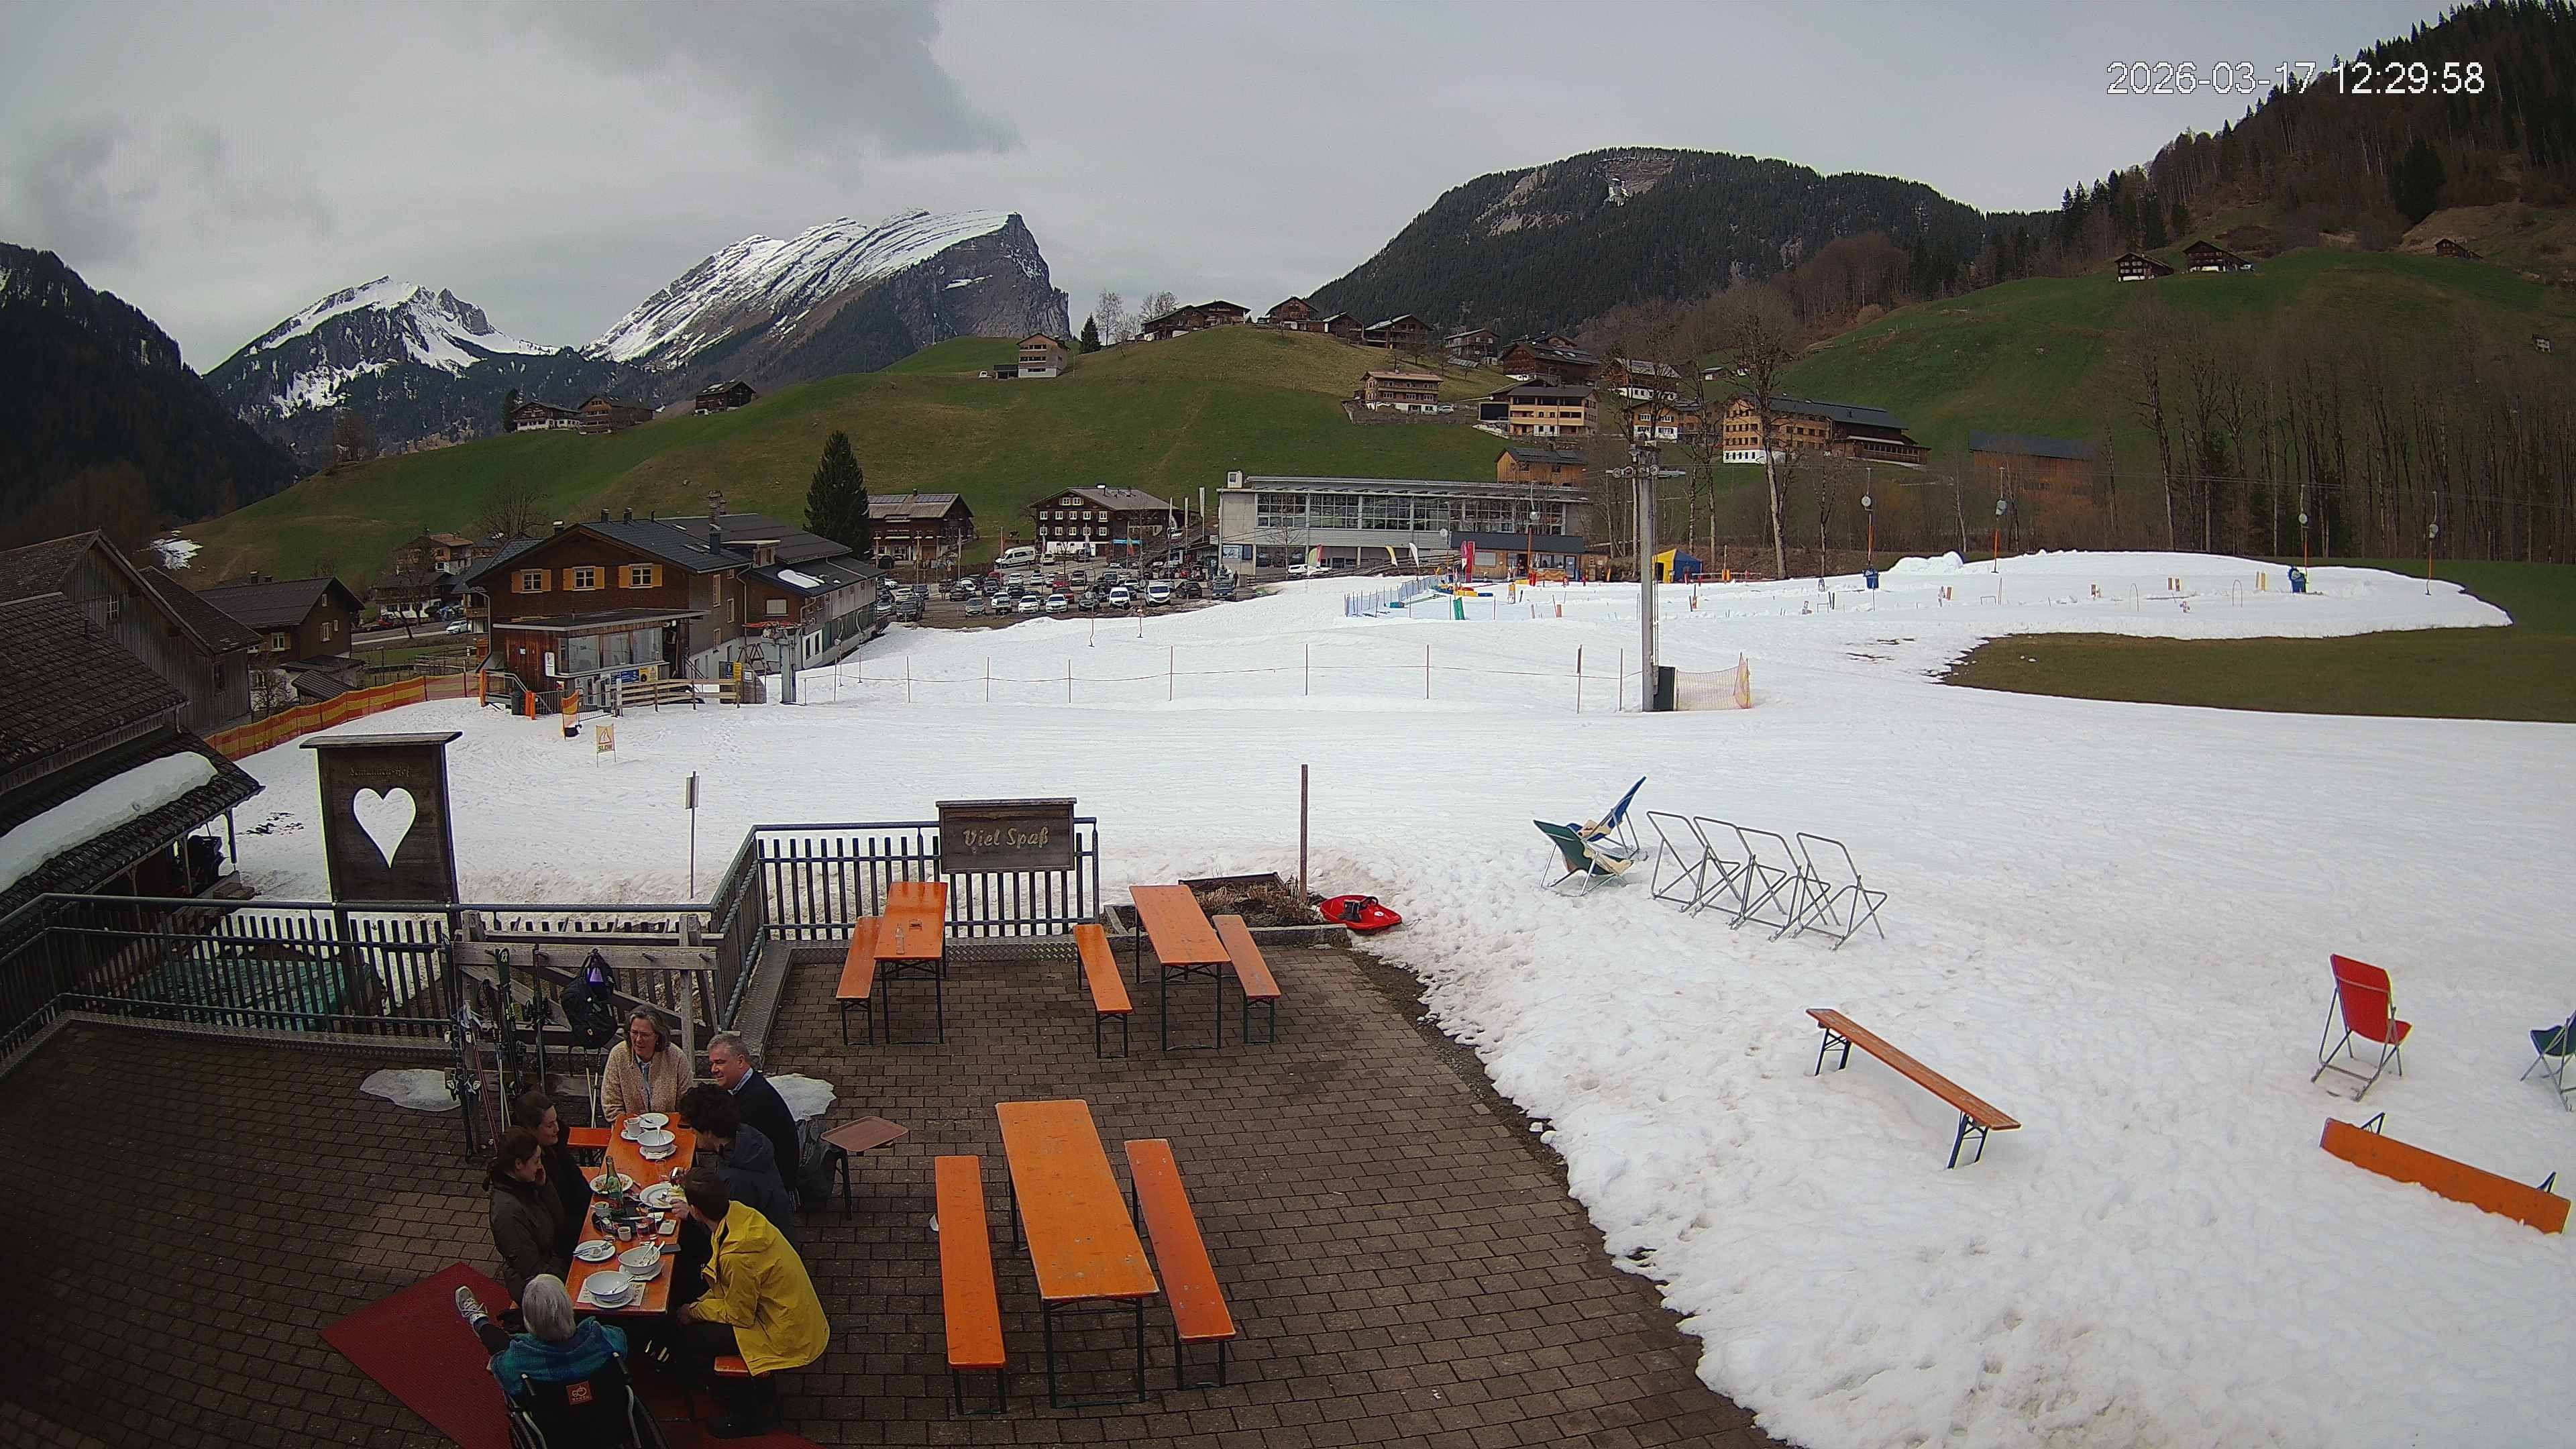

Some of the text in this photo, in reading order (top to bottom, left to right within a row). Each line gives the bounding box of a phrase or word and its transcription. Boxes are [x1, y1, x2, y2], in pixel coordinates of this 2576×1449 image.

[963, 826, 1049, 849] Viel Spaß
[451, 1014, 463, 1080] ARMADA
